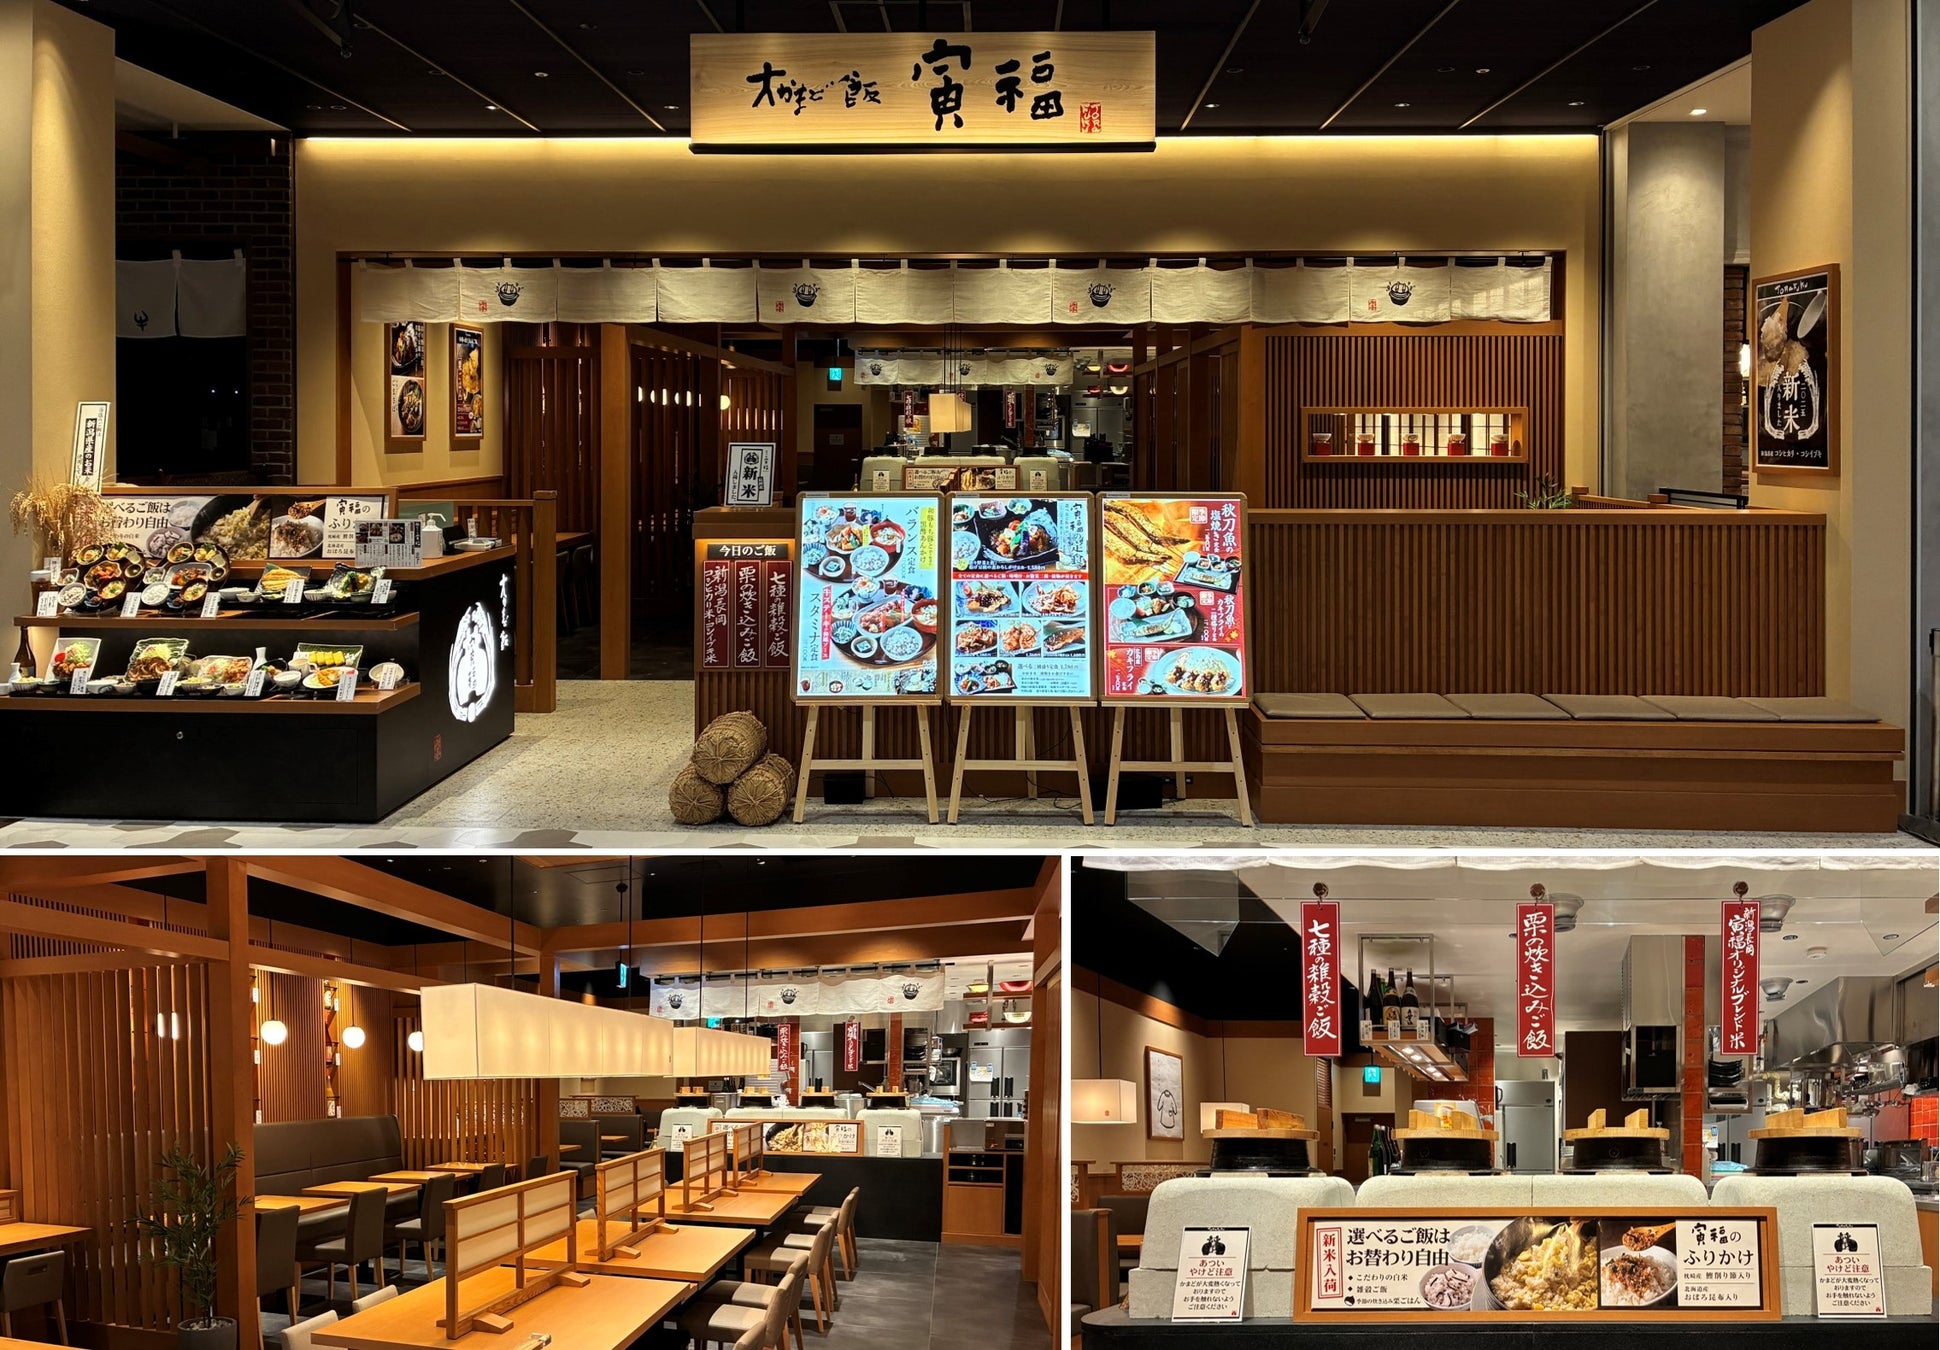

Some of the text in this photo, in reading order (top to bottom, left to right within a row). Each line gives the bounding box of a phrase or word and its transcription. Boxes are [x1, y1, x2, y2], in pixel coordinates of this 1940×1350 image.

[746, 38, 1065, 131] 大かまど飯 寅福
[1782, 371, 1801, 433] 新米
[741, 466, 758, 499] 新米
[336, 498, 371, 515] 寅福の
[905, 506, 919, 575] バランス定食
[1221, 502, 1237, 554] 秋刀魚の
[719, 545, 777, 557] 今日のご飯
[712, 565, 729, 627] 新潟長岡
[736, 565, 759, 663] 栗の炊き込みご飯
[767, 571, 789, 658] 七種の雑穀ご飯
[809, 593, 821, 662] スタミナ定食
[1126, 647, 1134, 691] カキフライ
[1742, 906, 1757, 957] 新潟長岡
[1307, 919, 1337, 1040] 七種の雑穀ご飯
[1520, 911, 1552, 1050] 栗の炊き込みご飯
[1727, 914, 1750, 1050] 寅福オリジナルブレンド米
[1347, 1227, 1451, 1245] 選べるご飯は
[1691, 1222, 1742, 1246] 寅福の
[1189, 1268, 1233, 1277] やけど注意
[1199, 1259, 1225, 1268] あつい
[1322, 1233, 1337, 1293] 新米入荷
[1346, 1248, 1449, 1267] お替わり自由
[1683, 1249, 1754, 1266] ふりかけ
[1827, 1264, 1870, 1273] やけど注意
[1834, 1256, 1860, 1264] あつい
[1180, 1280, 1241, 1288] かまどが大変熱くなって
[1356, 1273, 1408, 1281] こだわりの白米
[1356, 1285, 1388, 1293] 雑穀ご飯
[1188, 1303, 1228, 1311] ご注意ください
